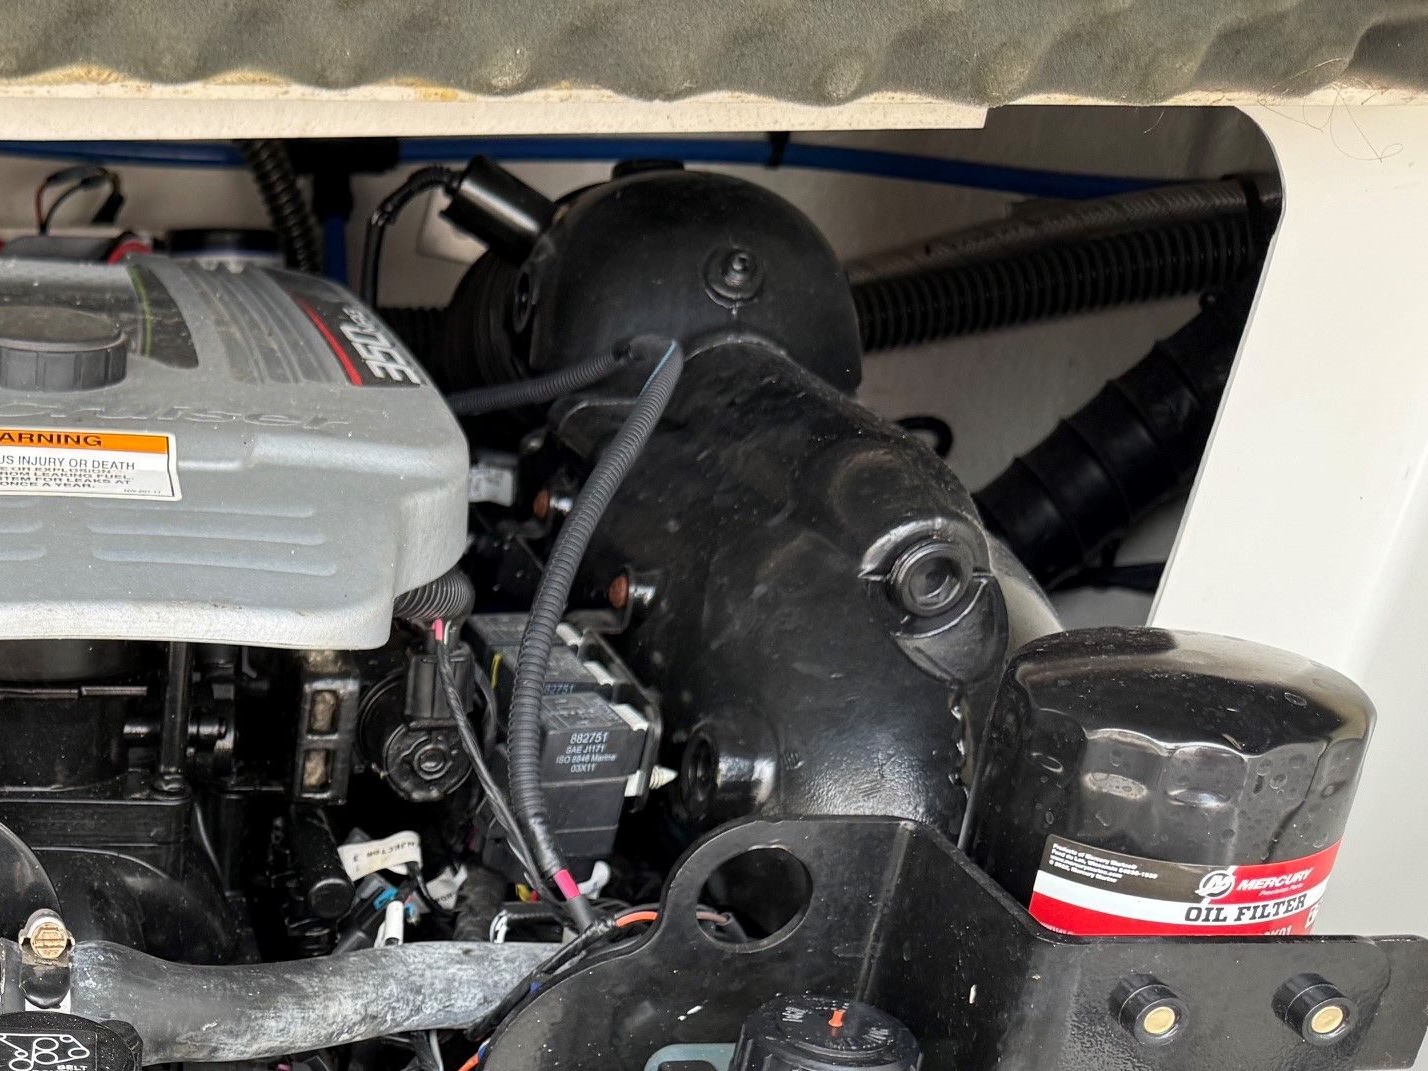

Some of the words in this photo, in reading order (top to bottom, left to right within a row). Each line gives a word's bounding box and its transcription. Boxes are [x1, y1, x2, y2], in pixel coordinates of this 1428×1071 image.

[339, 322, 421, 385] 350
[18, 455, 65, 466] INJURY
[68, 458, 88, 468] OR
[92, 460, 135, 470] DEATH
[542, 683, 573, 695] 82751
[569, 731, 608, 744] 882751
[556, 755, 570, 763] ISO
[590, 753, 616, 762] Marine
[367, 842, 415, 857] NJECTOR
[1236, 868, 1314, 891] MERCURY
[1184, 906, 1228, 923] OIL
[1234, 893, 1307, 922] FILTER
